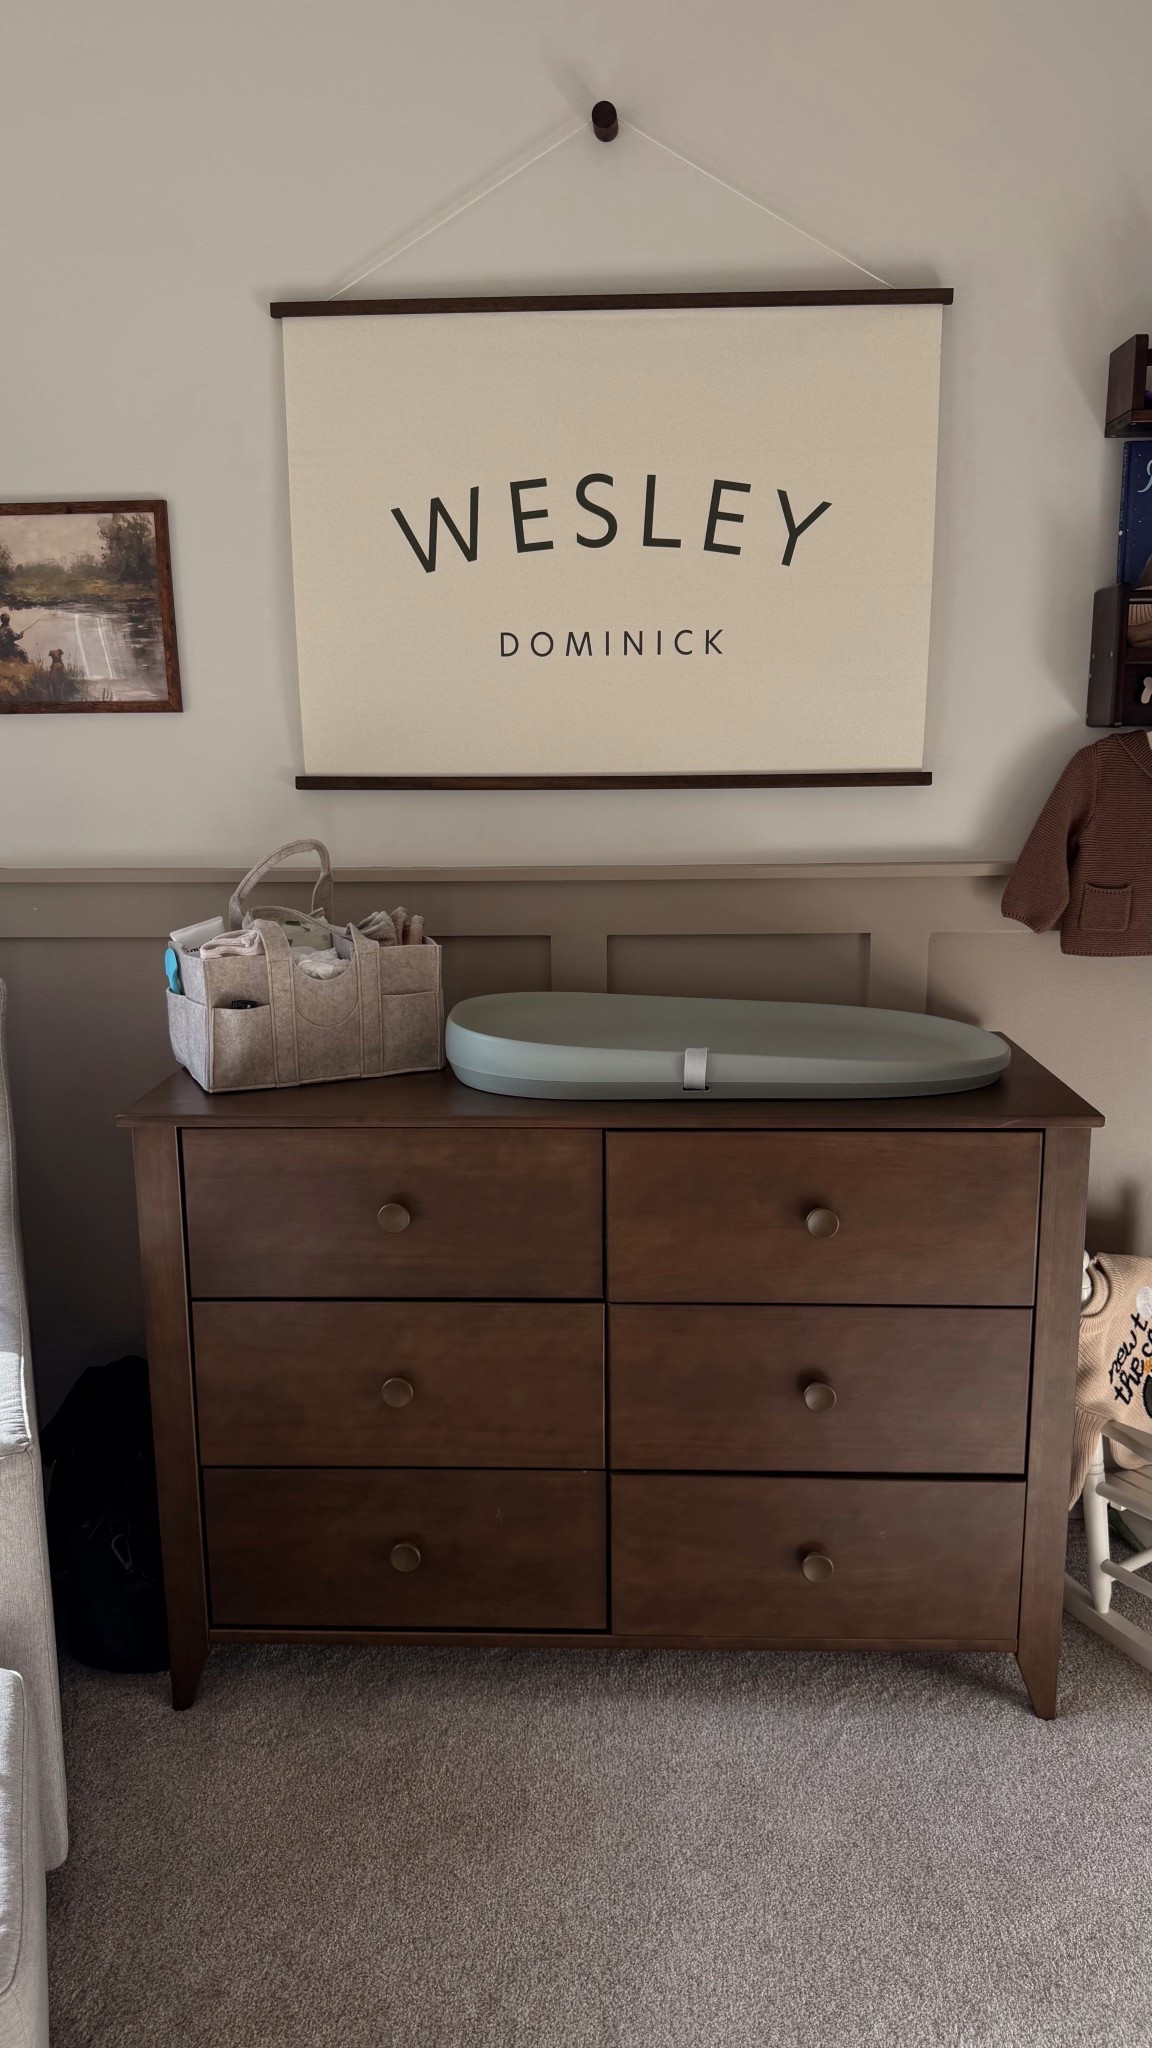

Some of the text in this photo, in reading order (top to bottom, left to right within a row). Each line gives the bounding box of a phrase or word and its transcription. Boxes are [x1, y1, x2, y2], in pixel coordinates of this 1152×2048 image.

[390, 472, 833, 574] WESLEY
[500, 629, 723, 658] DOMINICK
[1114, 1356, 1145, 1406] the
